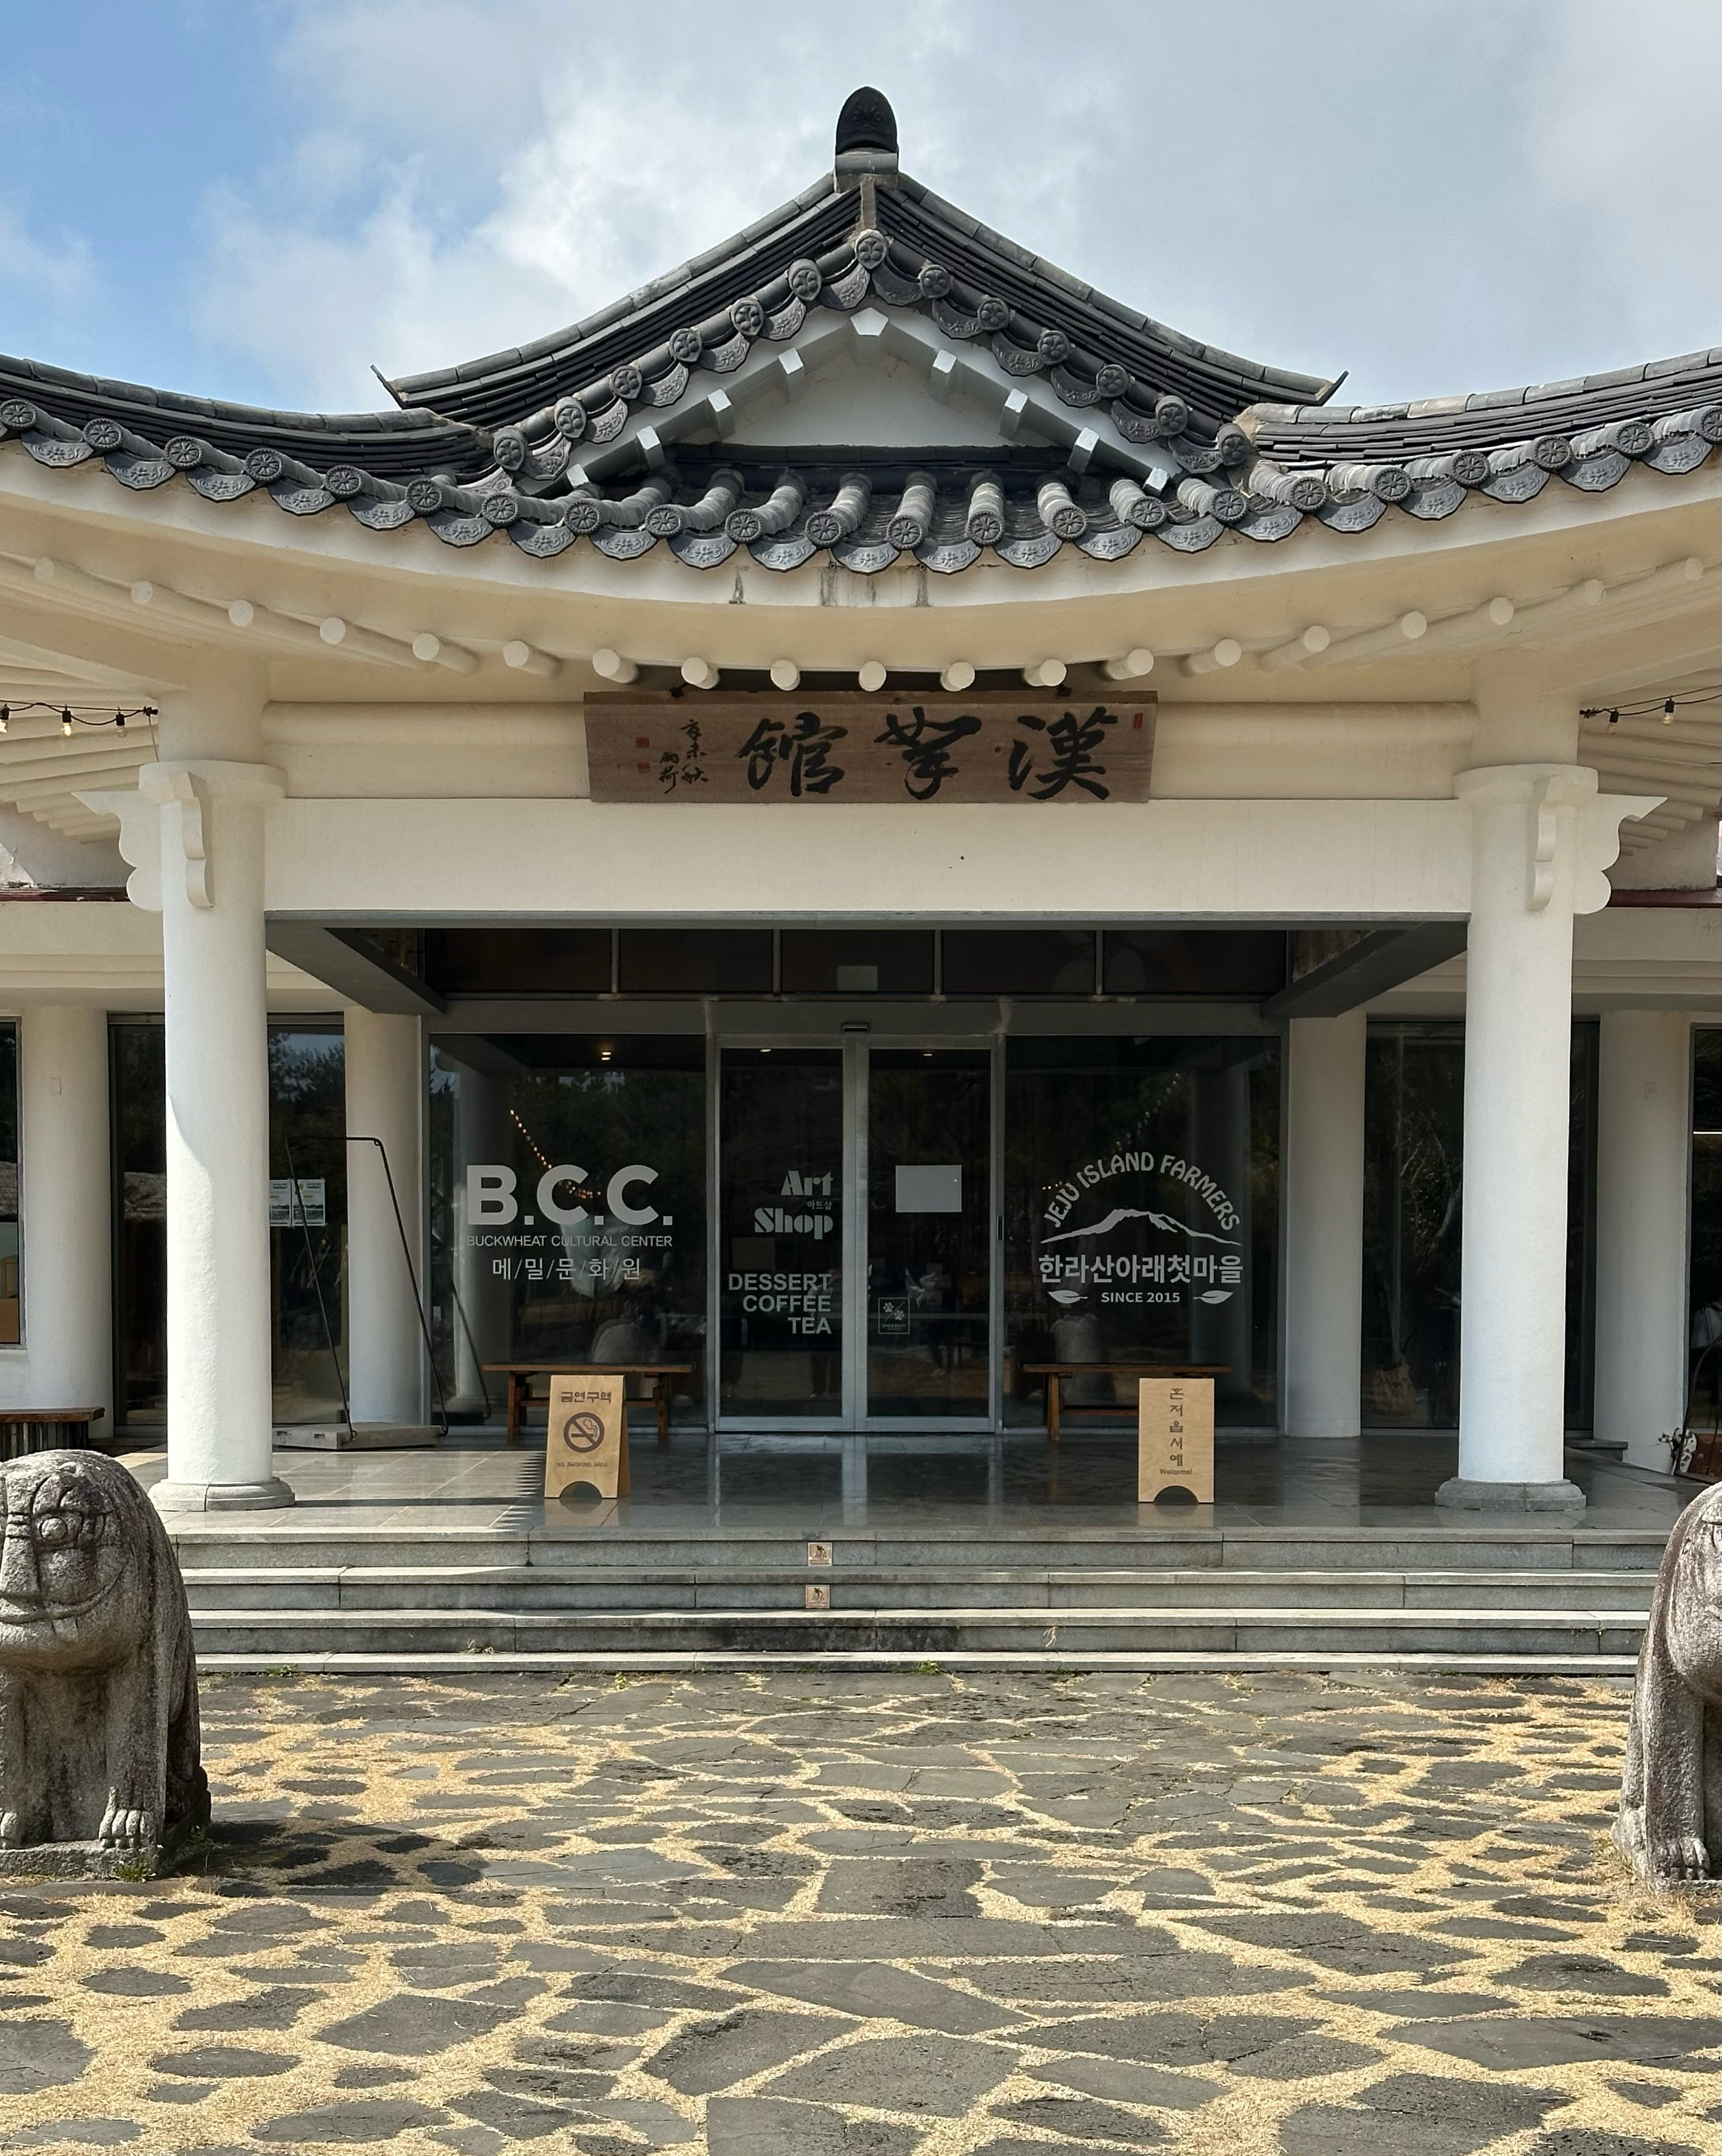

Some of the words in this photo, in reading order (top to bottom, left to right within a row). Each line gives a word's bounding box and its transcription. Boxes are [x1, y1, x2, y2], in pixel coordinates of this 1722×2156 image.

[780, 1170, 834, 1196] Art
[1043, 1182, 1080, 1228] JEJU
[1076, 1151, 1155, 1189] ISLAND
[1160, 1154, 1240, 1231] FARMERS
[466, 1164, 673, 1225] B.C.C.
[754, 1207, 834, 1240] Shop
[467, 1235, 547, 1247] BUCKWHEAT
[551, 1235, 617, 1247] CULTURAL
[621, 1235, 673, 1247] CENTER
[1038, 1254, 1244, 1284] 한라산아래첫마을
[728, 1273, 832, 1291] DESSERT
[742, 1294, 832, 1312] COFFEE
[1101, 1292, 1144, 1303] SINCE
[1146, 1292, 1181, 1303] 2015
[787, 1317, 832, 1335] TEA
[560, 1391, 612, 1404] 금연구역
